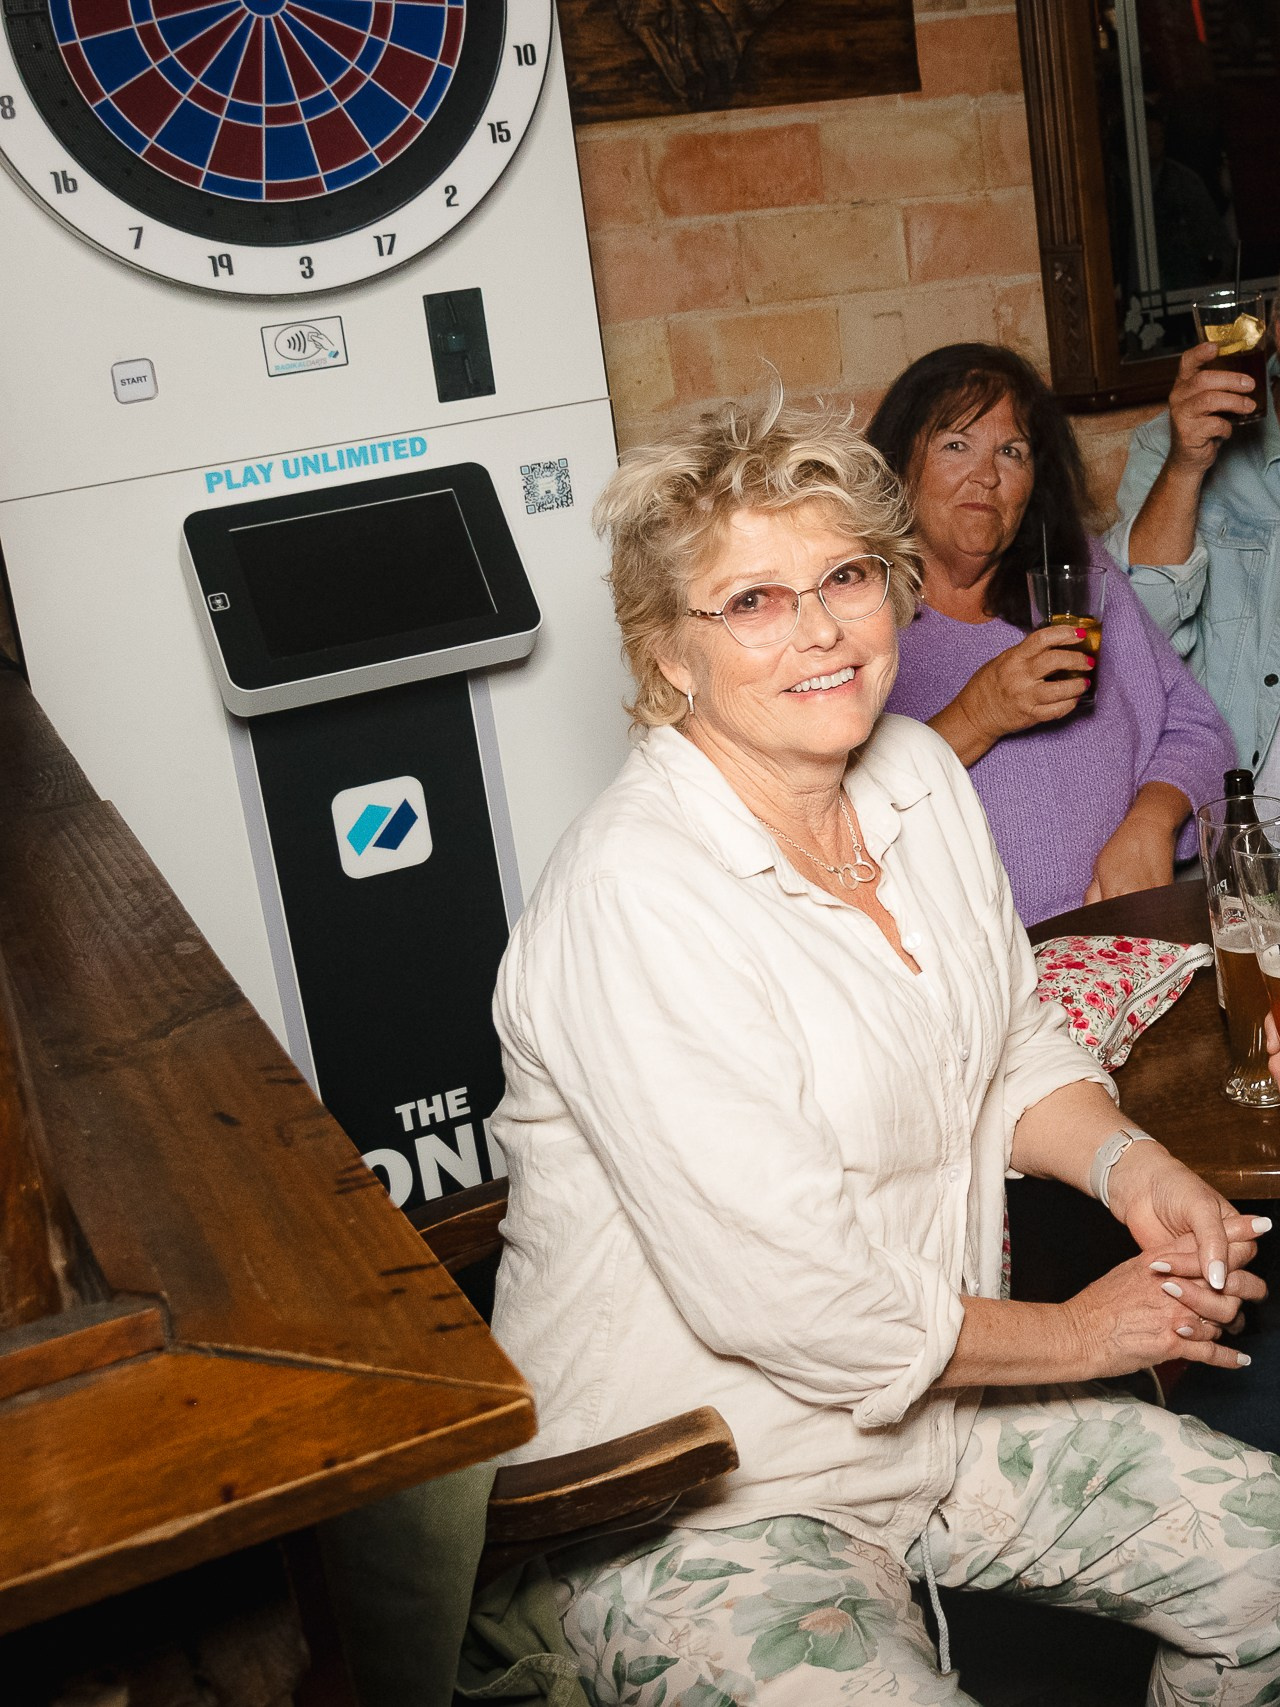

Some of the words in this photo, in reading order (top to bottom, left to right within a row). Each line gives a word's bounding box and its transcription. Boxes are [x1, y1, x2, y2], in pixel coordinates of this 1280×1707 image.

[513, 44, 537, 67] 10
[0, 95, 16, 119] 8
[488, 120, 511, 144] 15
[50, 170, 78, 194] 16
[444, 184, 459, 208] 2
[128, 226, 144, 250] 7
[373, 233, 397, 257] 17
[208, 254, 234, 278] 19
[299, 256, 315, 279] 3
[120, 375, 148, 387] START
[204, 462, 274, 494] PLAY
[282, 436, 428, 480] UNLIMITED
[394, 1086, 471, 1132] THE
